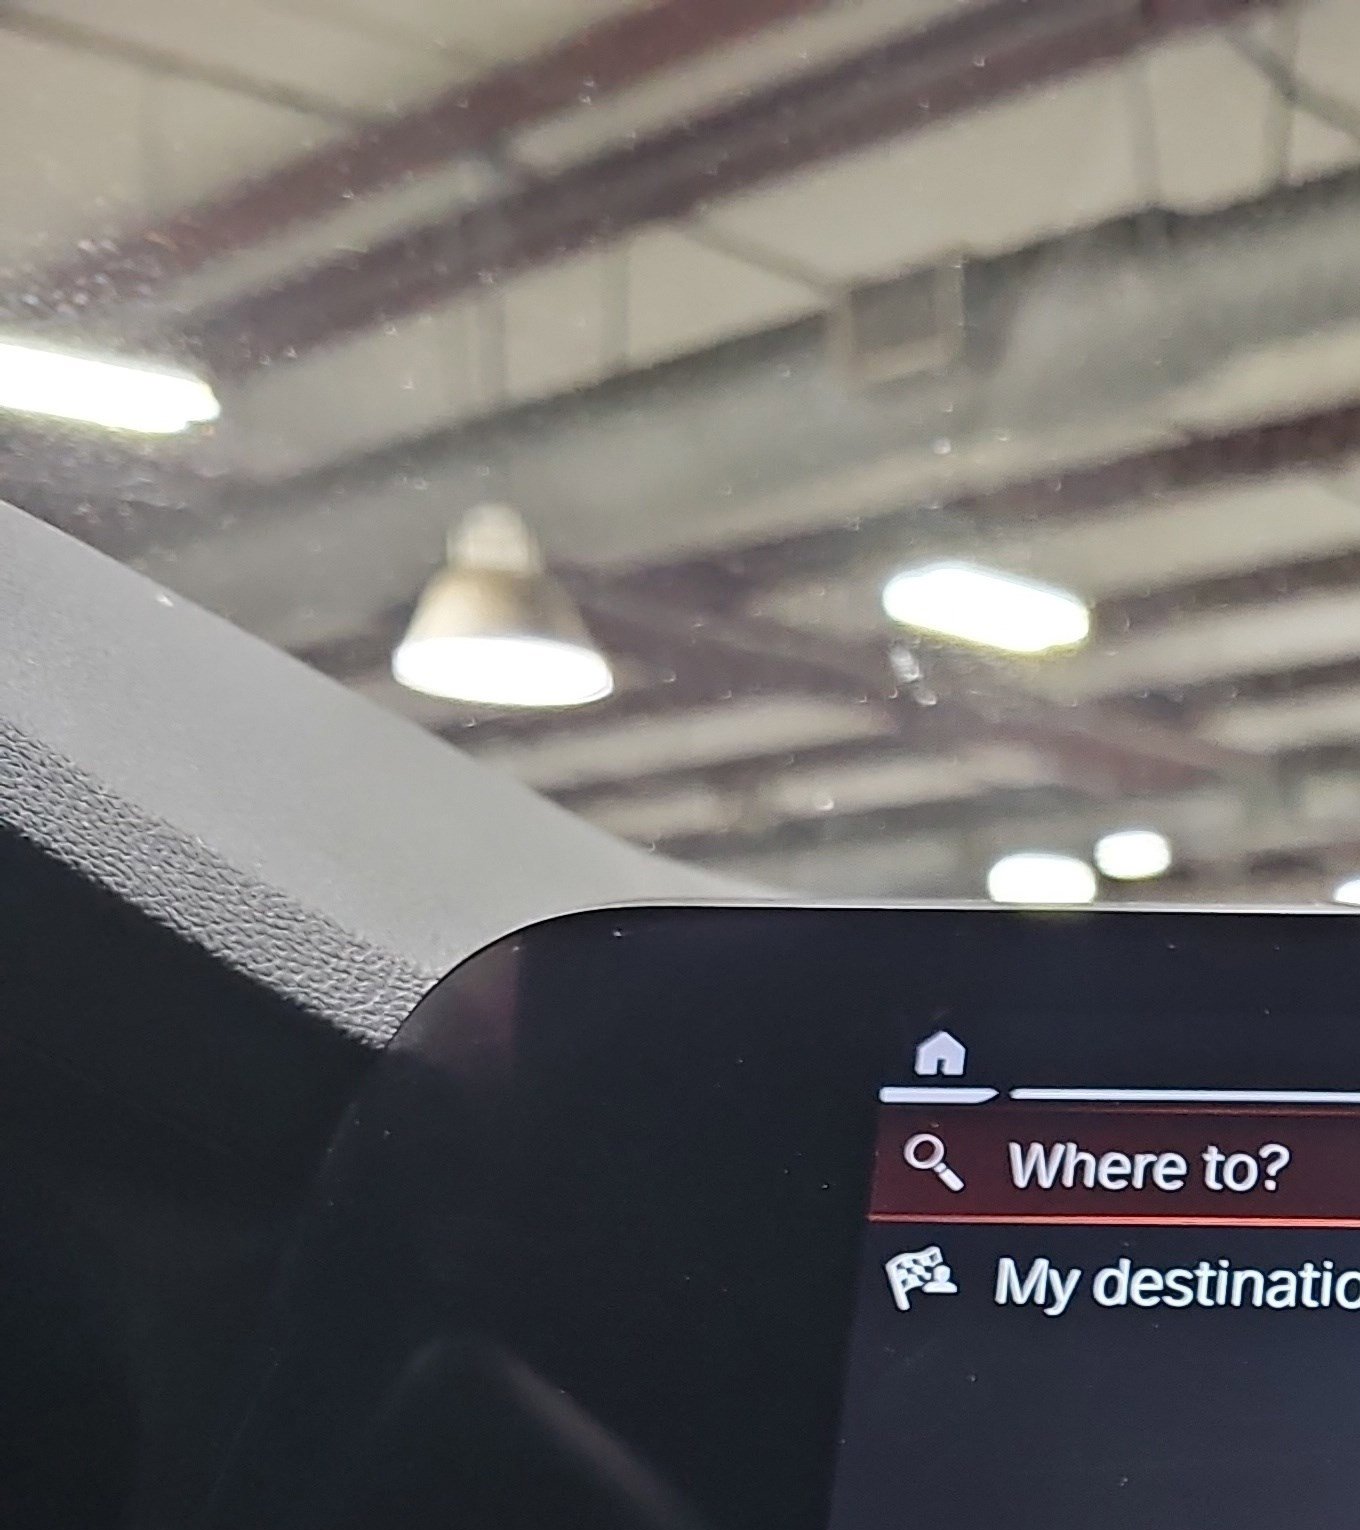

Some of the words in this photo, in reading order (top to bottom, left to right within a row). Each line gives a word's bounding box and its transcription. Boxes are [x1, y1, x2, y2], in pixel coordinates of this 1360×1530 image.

[1008, 1142, 1187, 1190] Where
[1203, 1144, 1291, 1190] to?
[993, 1258, 1082, 1317] My
